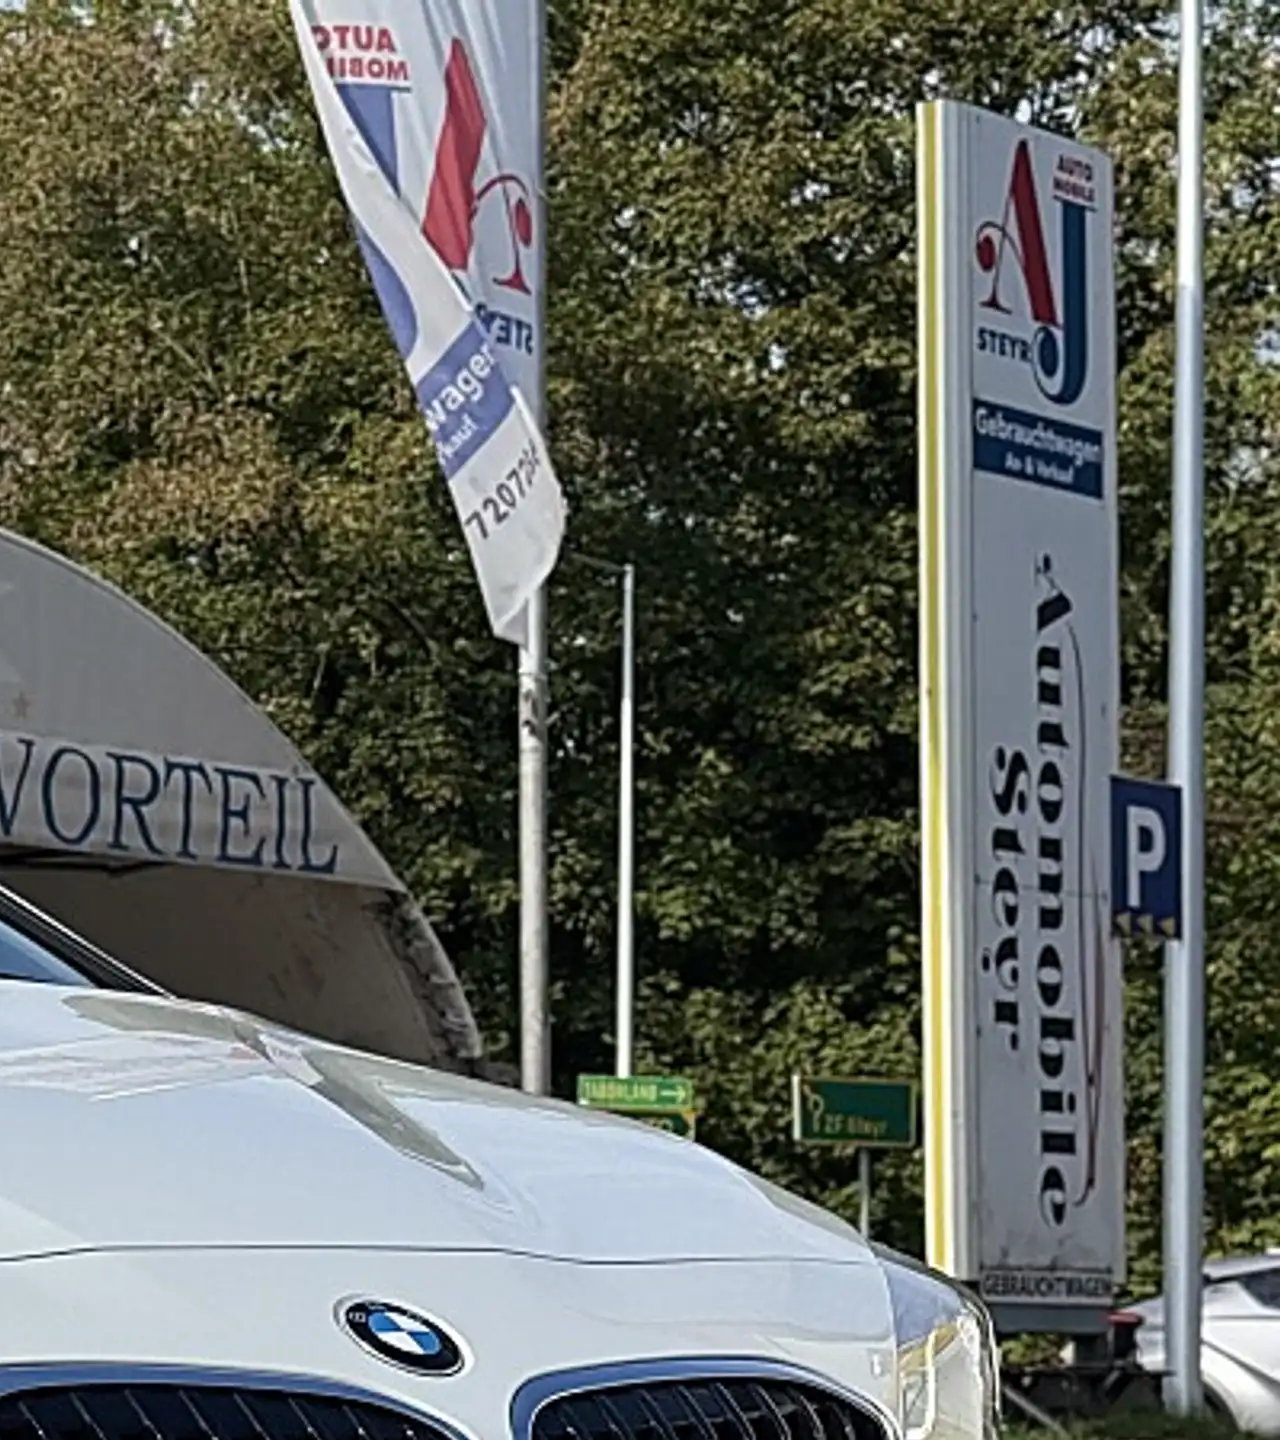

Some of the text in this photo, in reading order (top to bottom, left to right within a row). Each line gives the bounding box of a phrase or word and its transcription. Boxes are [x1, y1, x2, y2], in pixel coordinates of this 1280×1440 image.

[977, 326, 1032, 362] STEYR
[981, 745, 1029, 1052] Steyr
[1035, 555, 1077, 1227] Automobile
[1127, 805, 1166, 908] P
